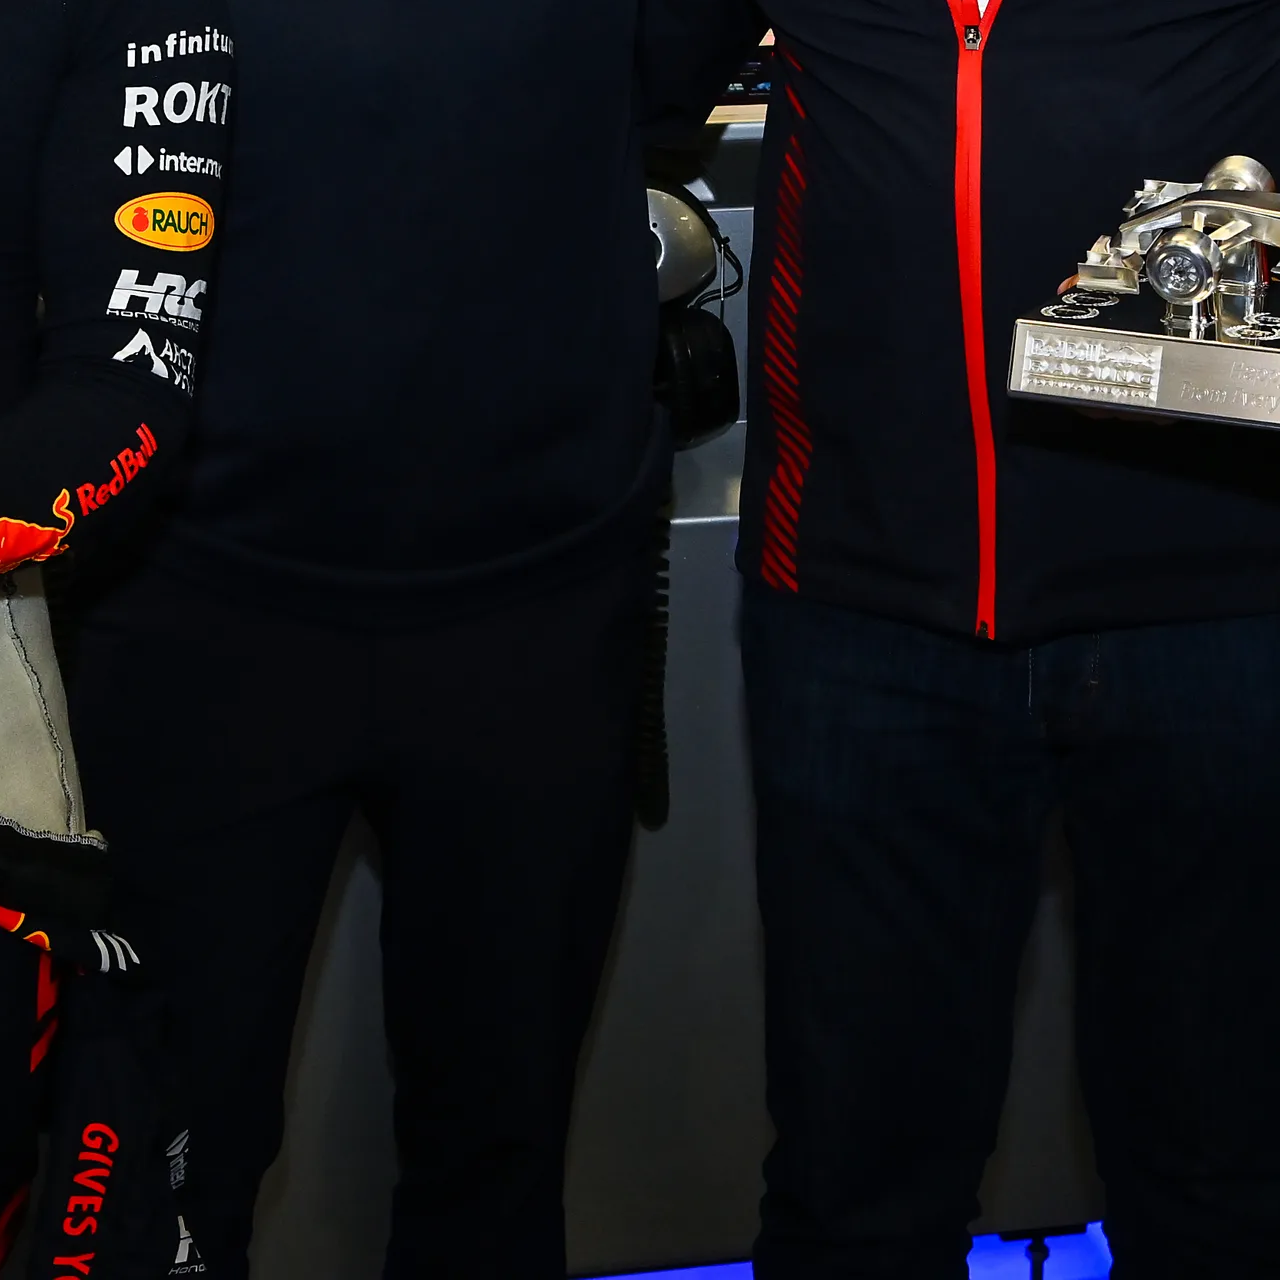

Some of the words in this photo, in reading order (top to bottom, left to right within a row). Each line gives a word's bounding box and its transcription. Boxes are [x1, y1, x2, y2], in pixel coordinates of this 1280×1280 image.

[123, 81, 232, 127] ROKT
[152, 208, 209, 236] RAUCH
[108, 269, 208, 321] HRC
[76, 461, 125, 517] Red
[119, 423, 158, 464] Bull
[63, 1122, 119, 1237] GIVES
